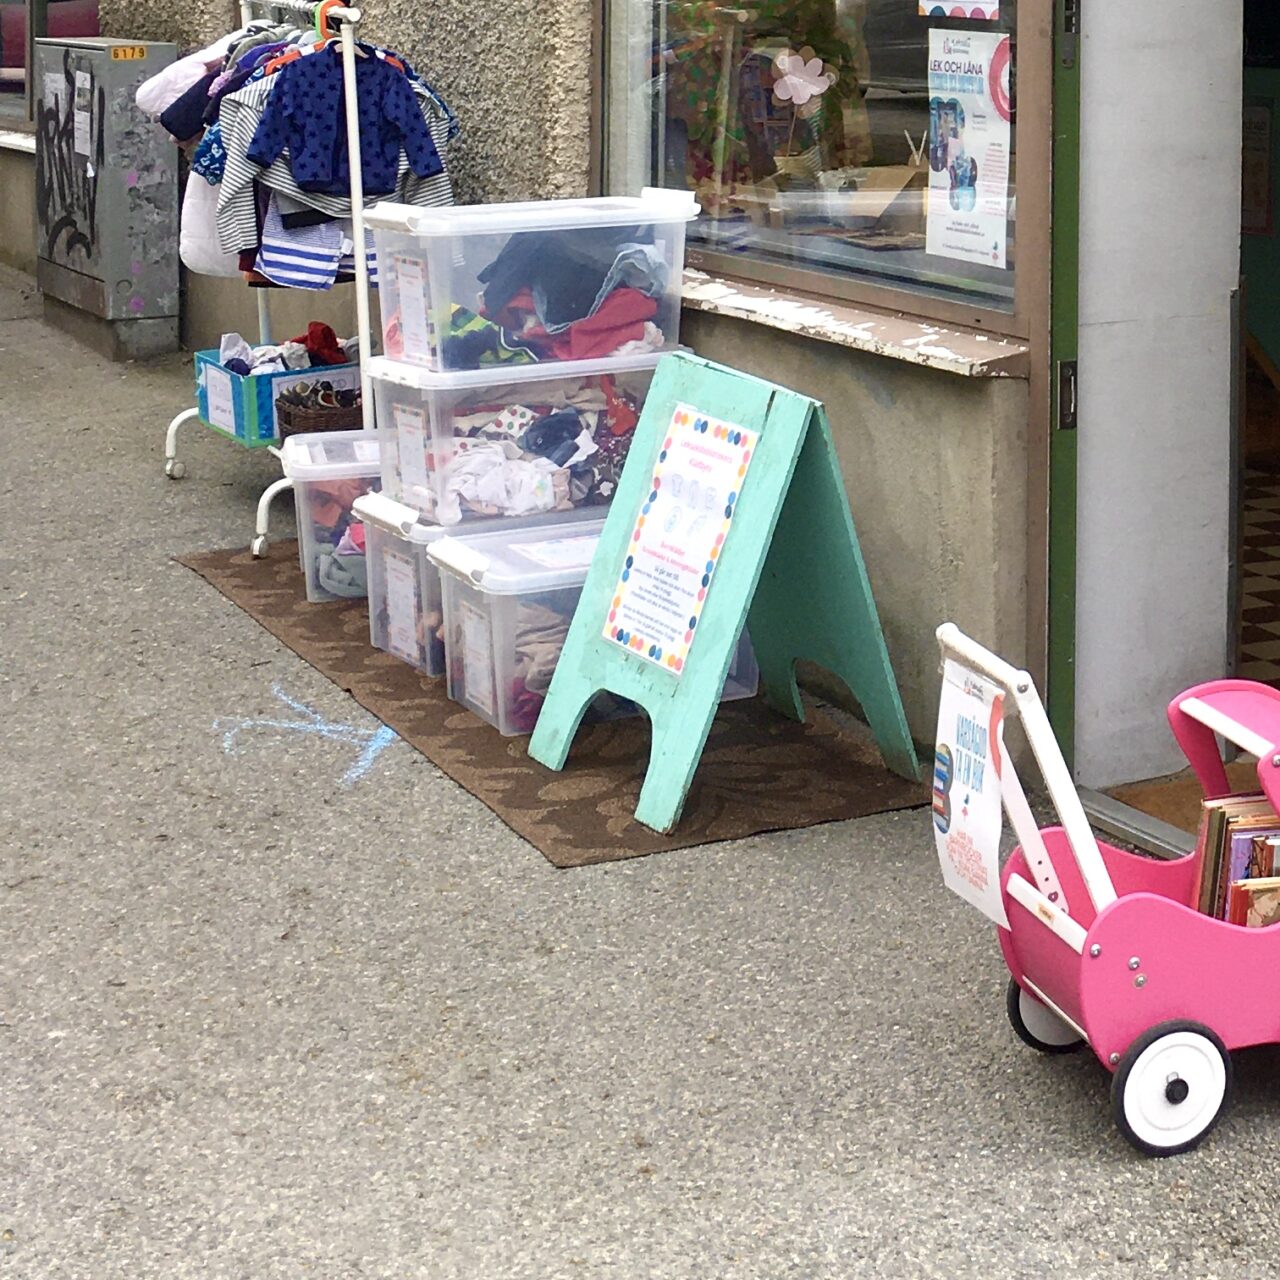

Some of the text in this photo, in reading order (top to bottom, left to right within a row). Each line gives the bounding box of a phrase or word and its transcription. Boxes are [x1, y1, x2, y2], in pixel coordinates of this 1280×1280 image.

[113, 47, 145, 59] 6179
[930, 60, 983, 75] LEK OCH LÅNA
